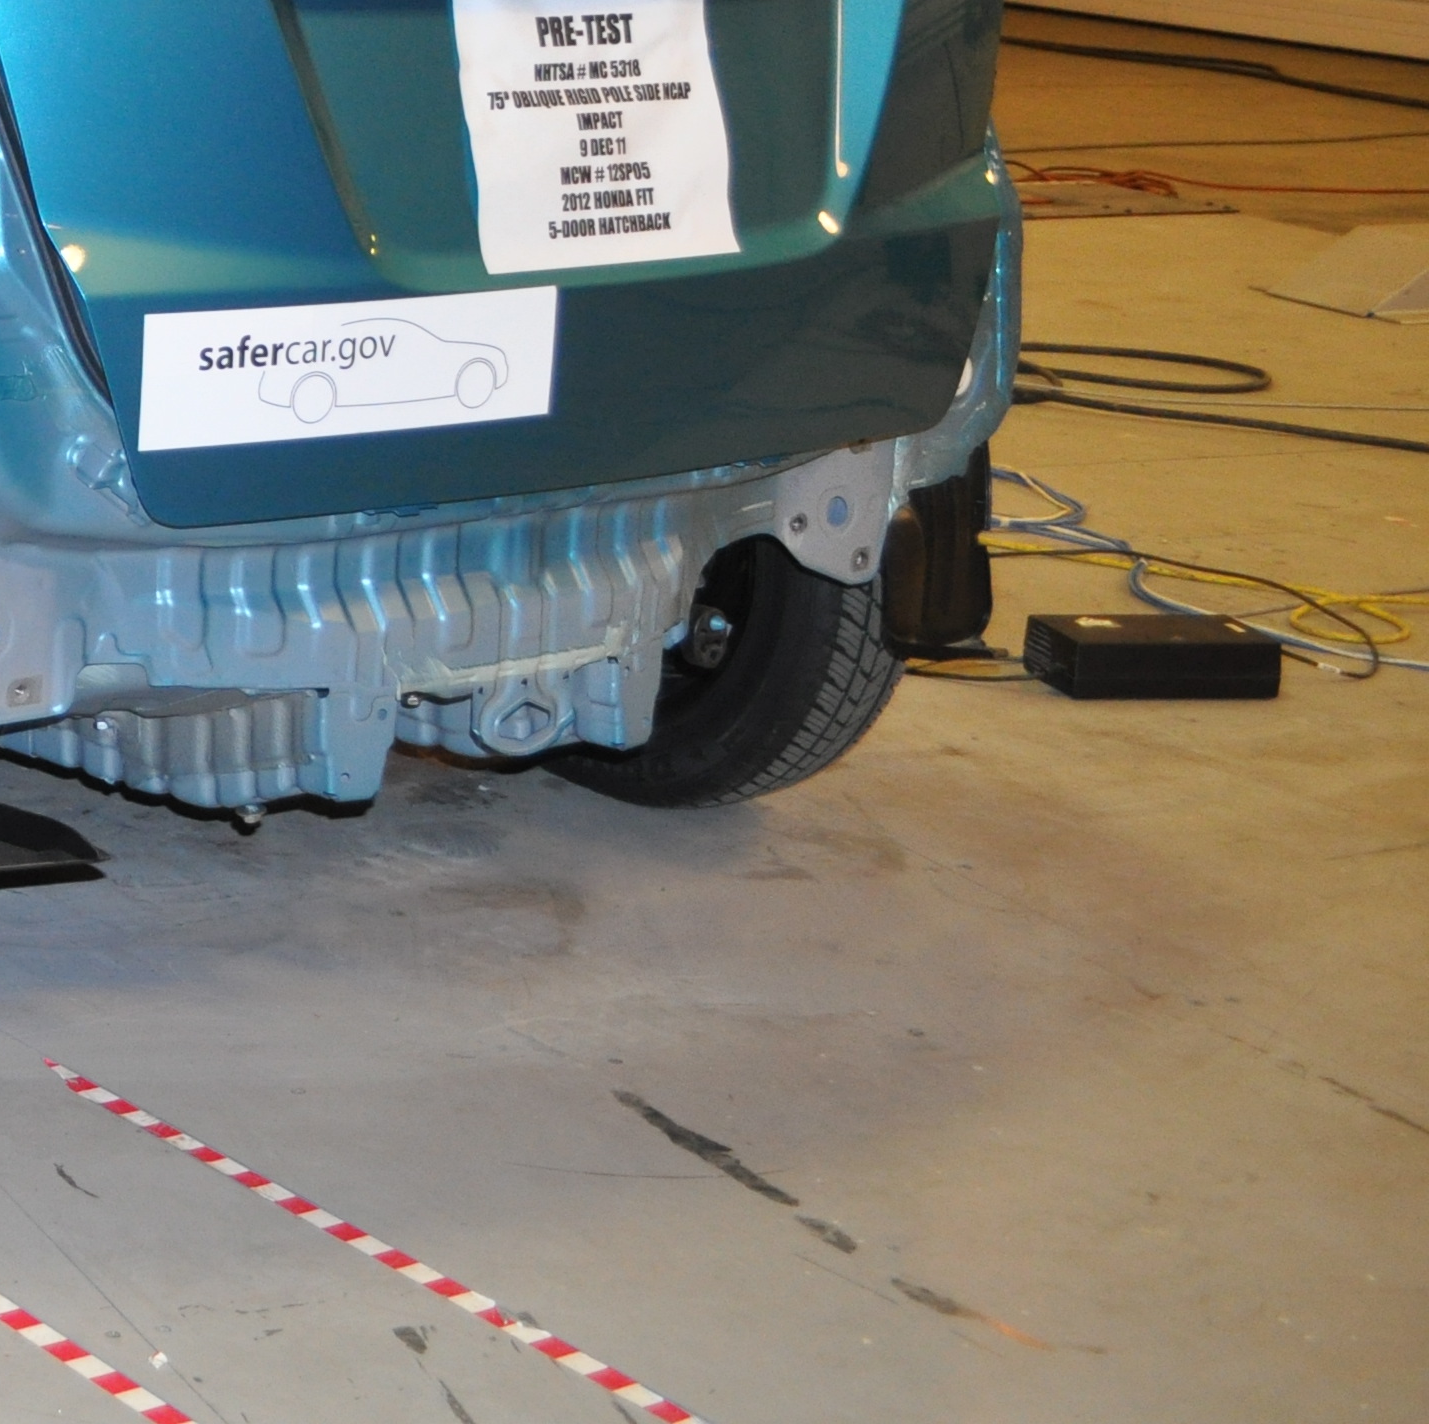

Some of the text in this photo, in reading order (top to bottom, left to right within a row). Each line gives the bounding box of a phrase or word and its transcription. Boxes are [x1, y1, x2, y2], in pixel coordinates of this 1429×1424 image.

[536, 14, 633, 47] PRE-TEST
[534, 59, 641, 82] NHTSA # MC 5318
[512, 88, 566, 109] OBLIQUE
[567, 86, 602, 106] RIGID
[604, 85, 634, 104] POLE
[636, 84, 661, 101] SIDE
[663, 82, 691, 100] NCAP
[576, 111, 623, 131] IMPACT
[580, 137, 626, 157] 9 DEC 11
[560, 166, 592, 185] MCW
[594, 167, 605, 182] #
[561, 188, 654, 212] 2012 HONDA FIT
[548, 212, 671, 239] 5-DOOR HATCHBACK
[199, 335, 396, 371] safercar.gov
